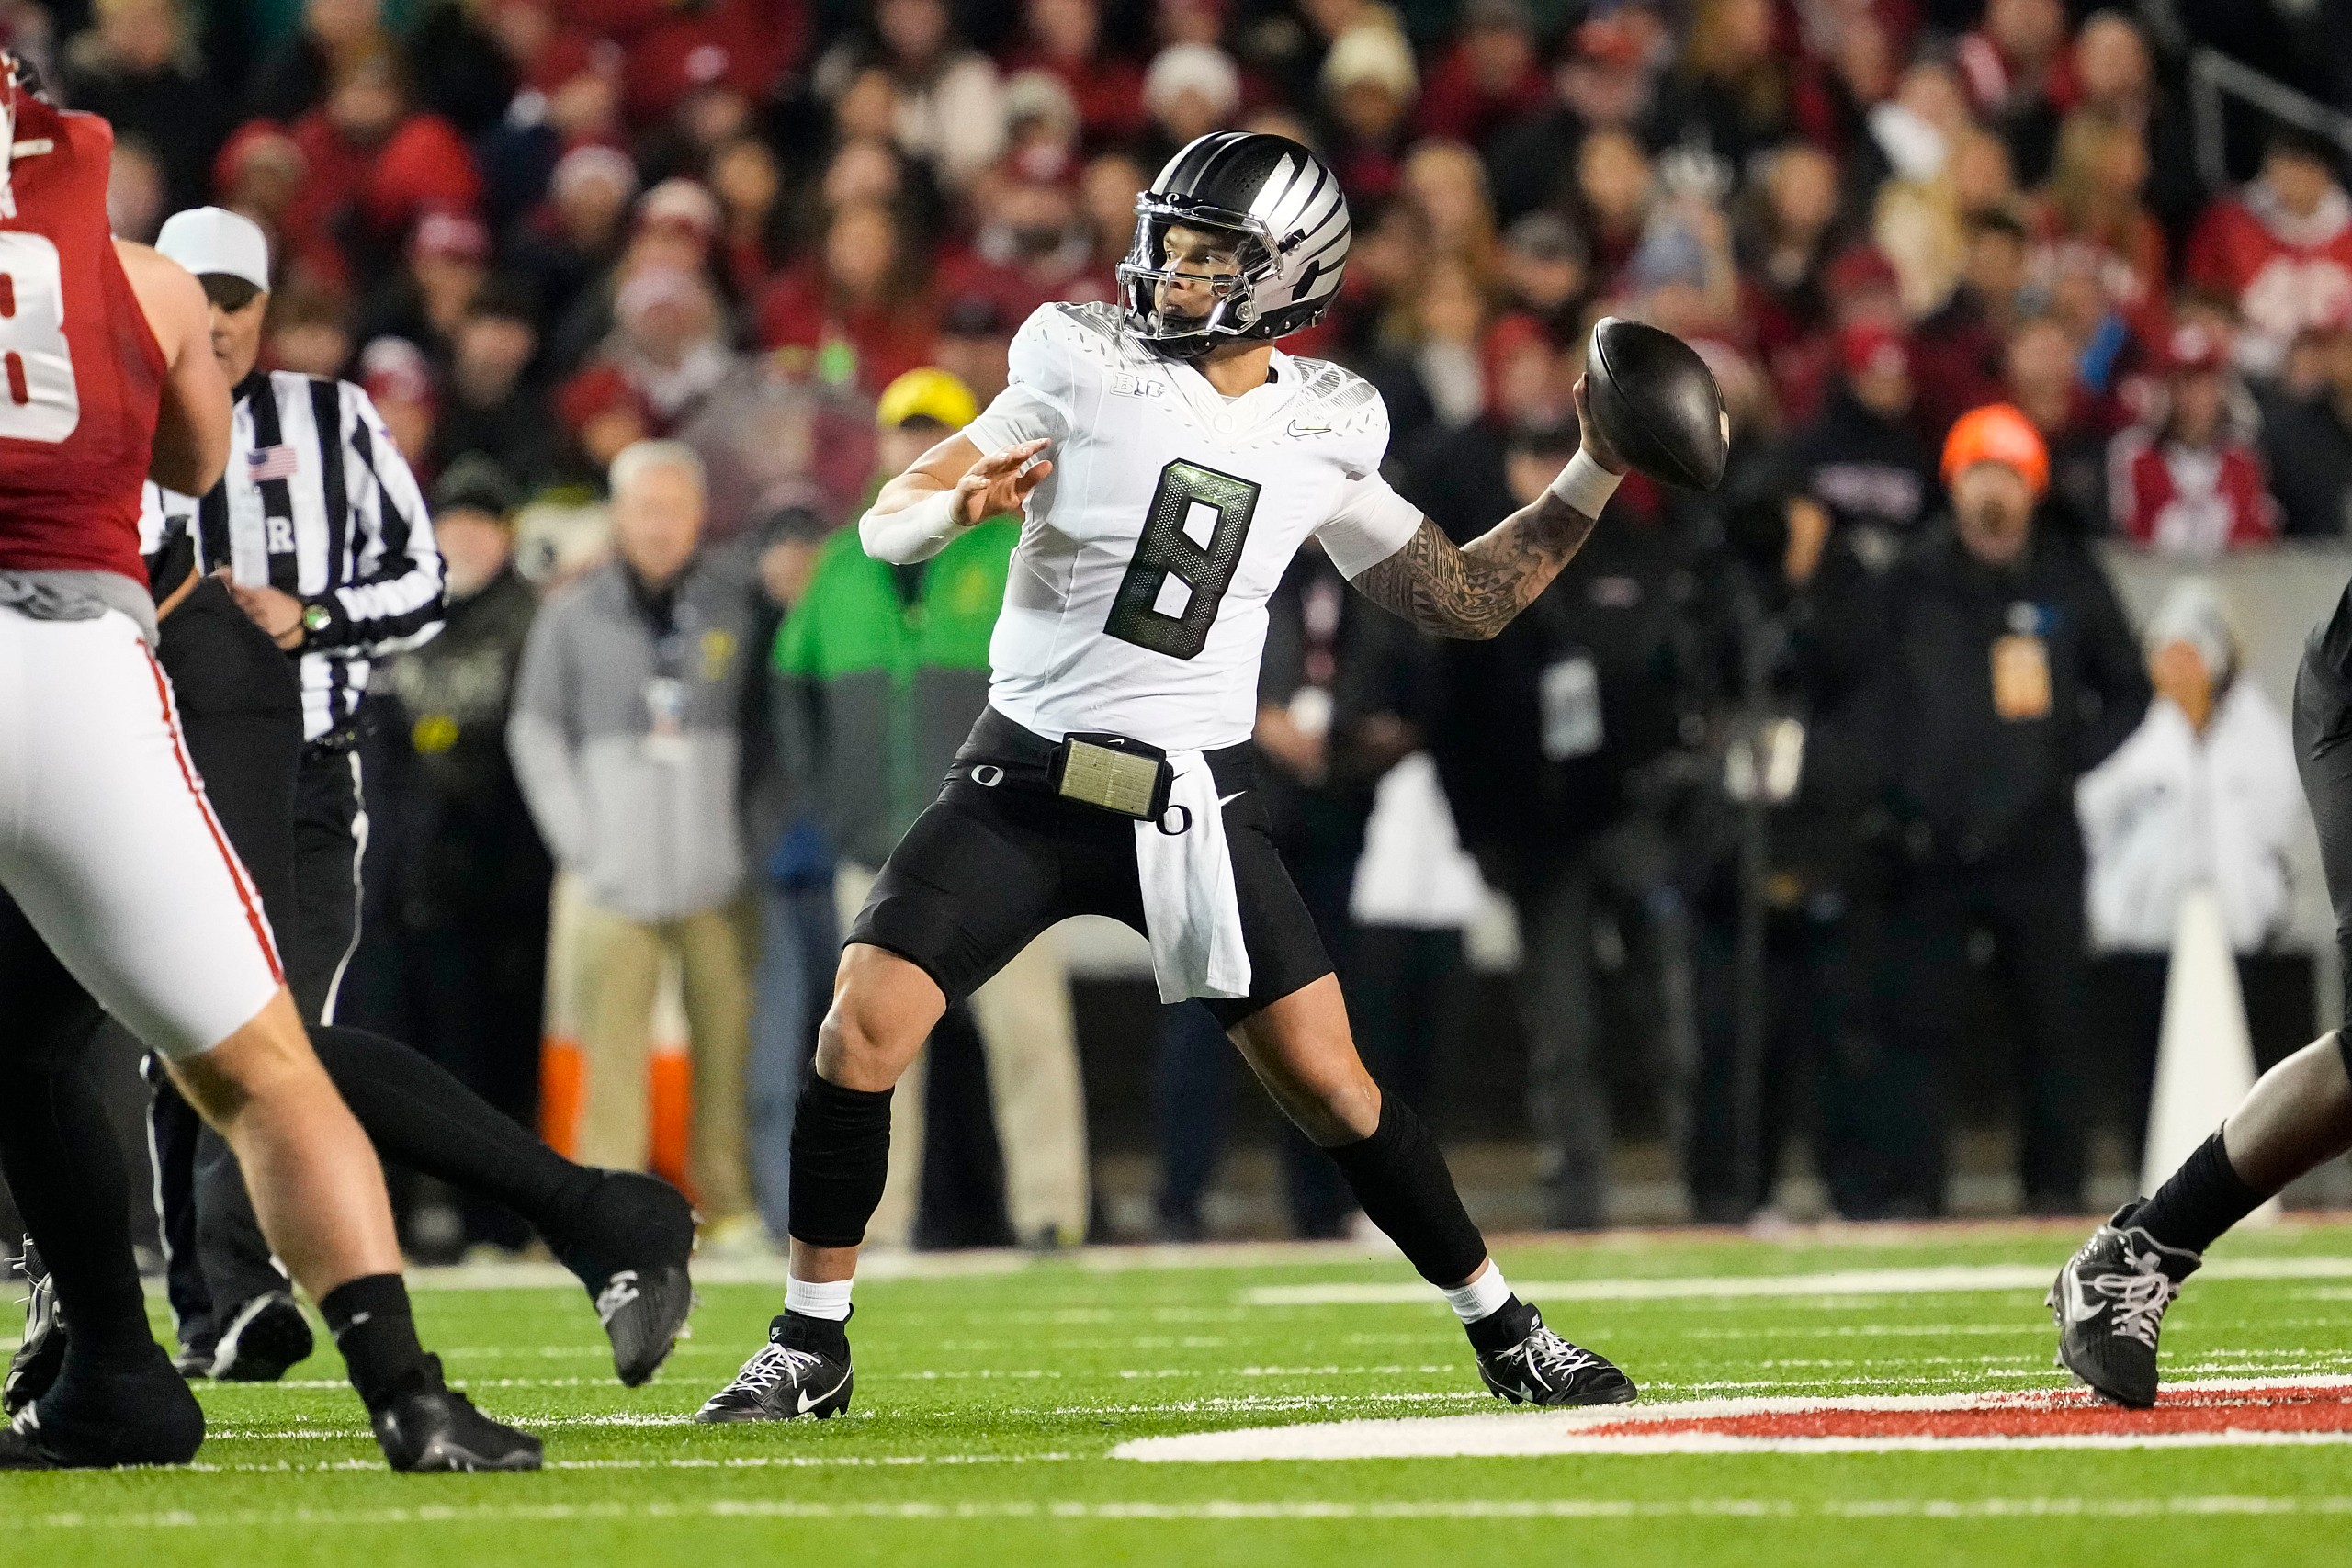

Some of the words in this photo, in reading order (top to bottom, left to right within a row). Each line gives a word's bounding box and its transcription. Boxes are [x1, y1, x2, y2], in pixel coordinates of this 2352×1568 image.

[0, 230, 80, 444] 8
[265, 515, 295, 554] R
[1102, 457, 1262, 661] 8
[971, 764, 1004, 787] O
[1155, 805, 1193, 836] O
